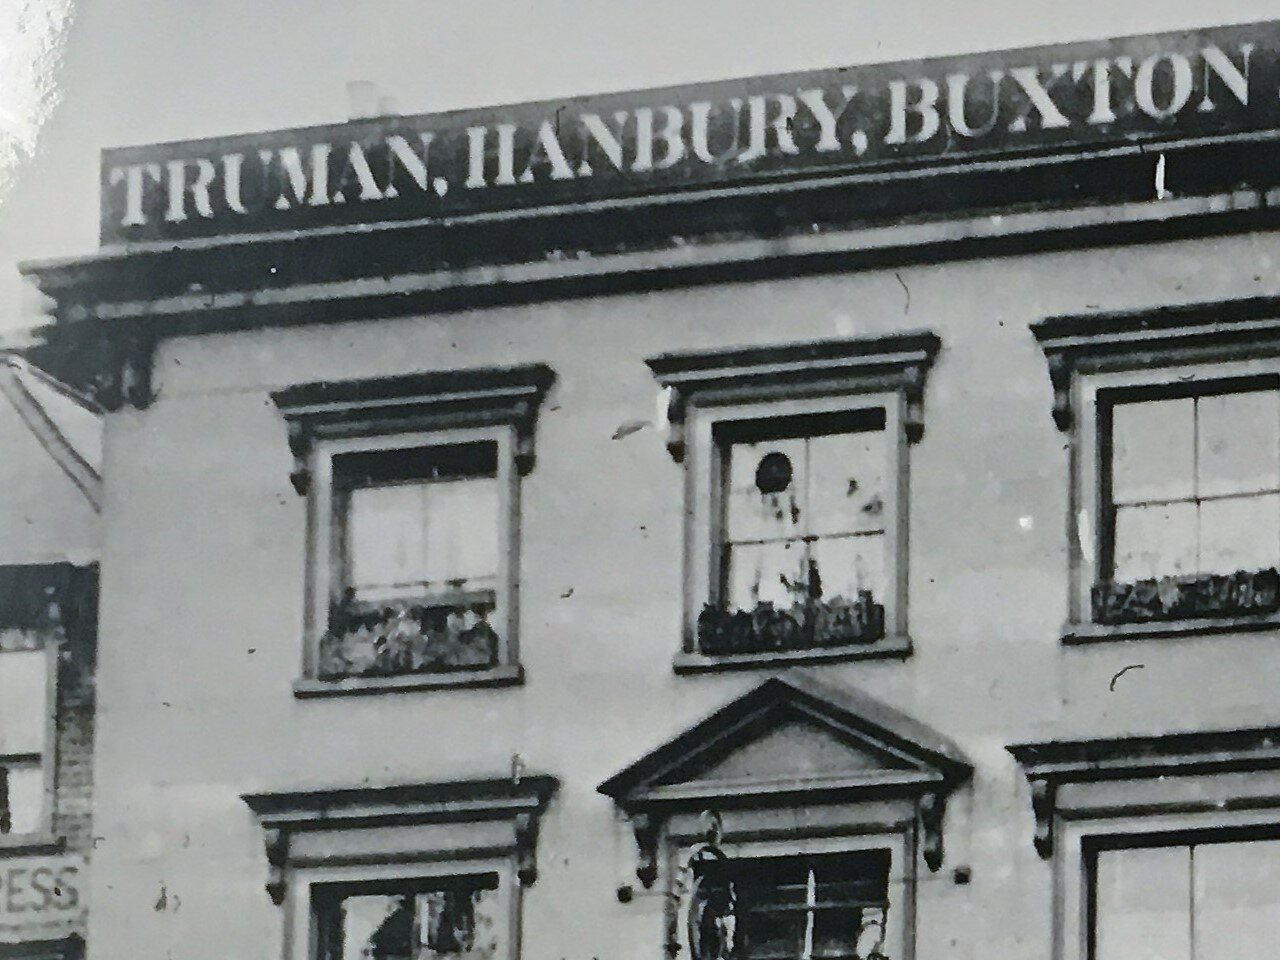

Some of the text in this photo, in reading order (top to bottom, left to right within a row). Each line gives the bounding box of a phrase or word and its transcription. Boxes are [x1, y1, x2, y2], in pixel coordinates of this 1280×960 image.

[111, 132, 448, 225] TRUMAN,
[464, 89, 869, 187] HANBURY,
[885, 42, 1253, 146] BUXTON
[0, 866, 79, 912] ESS
